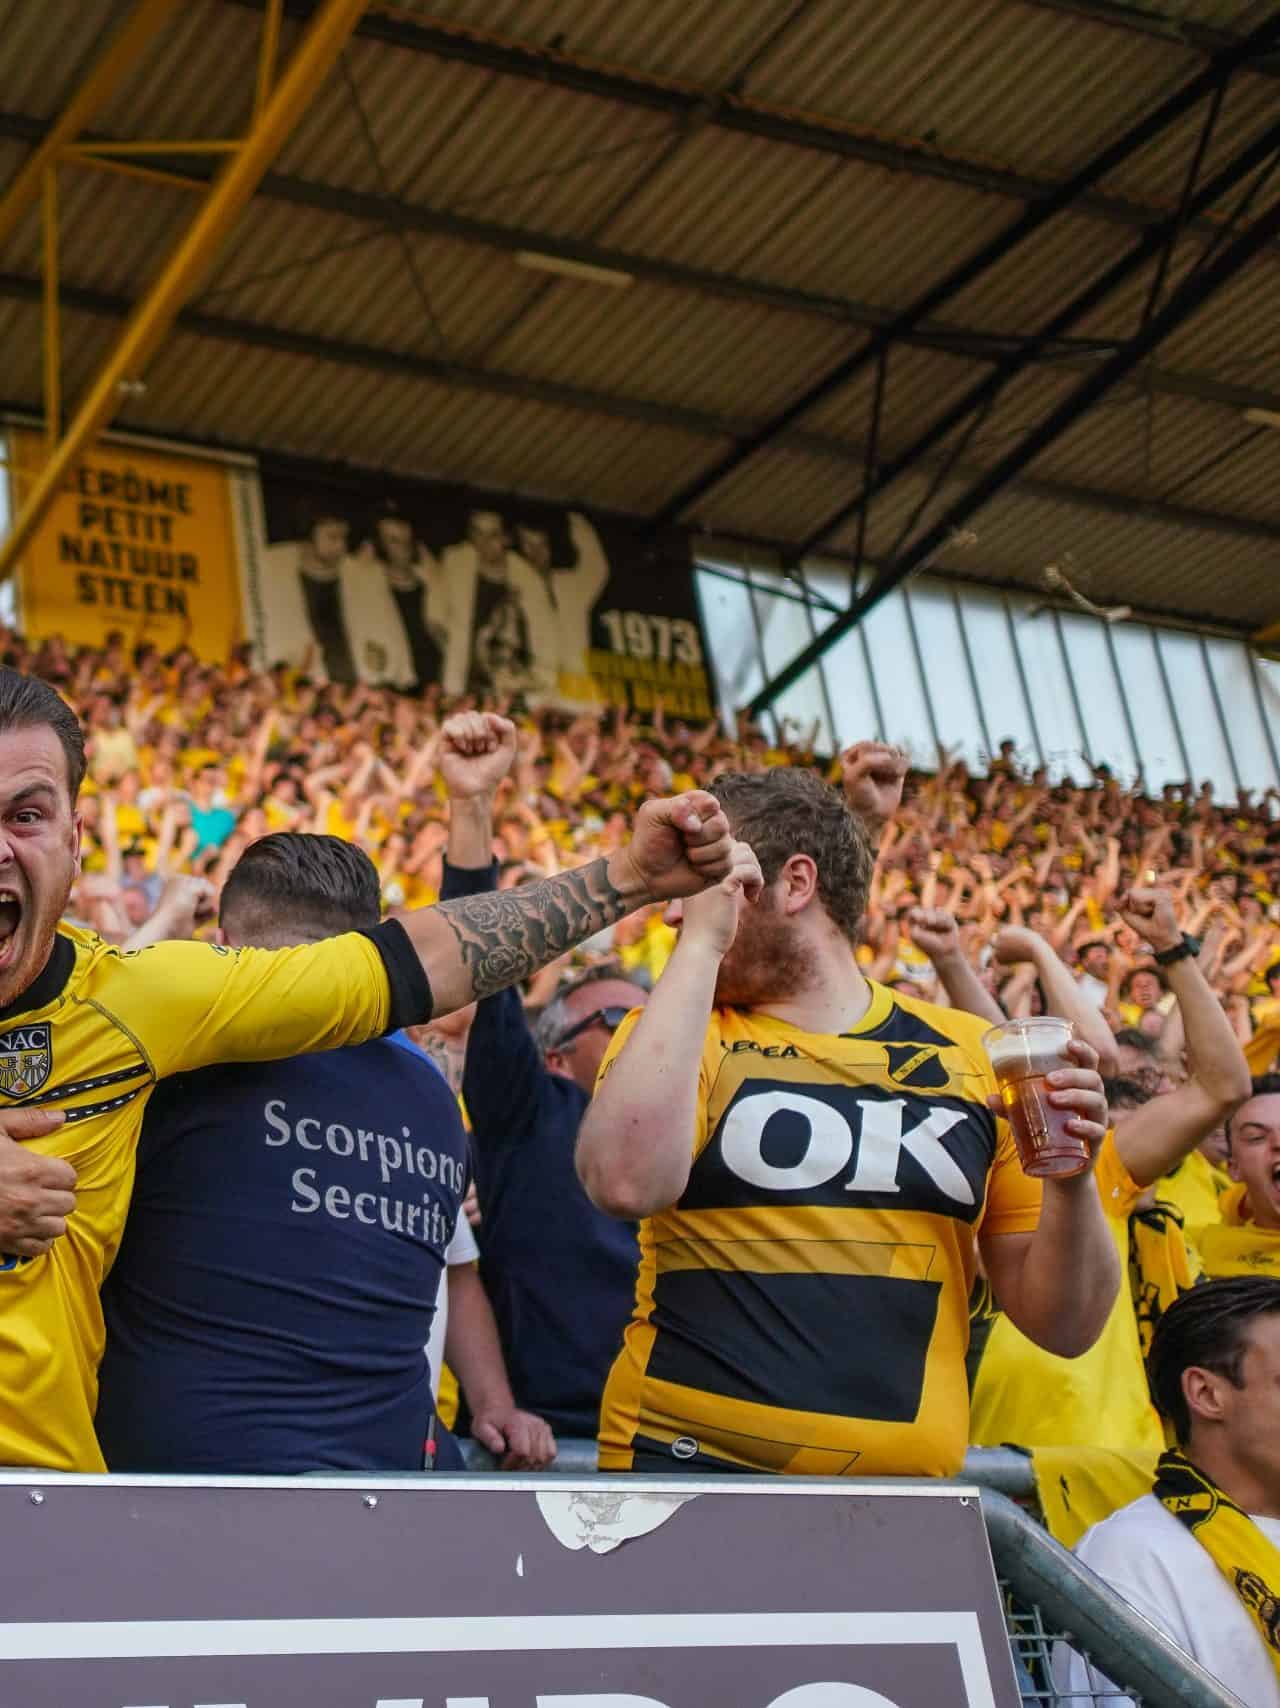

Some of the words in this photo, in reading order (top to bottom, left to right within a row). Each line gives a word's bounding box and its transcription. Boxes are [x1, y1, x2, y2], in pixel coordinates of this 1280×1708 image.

[60, 466, 192, 517] ERÔME
[79, 501, 173, 545] PETIT
[59, 532, 200, 583] NATUUR
[76, 571, 189, 618] STEEN
[600, 609, 701, 664] 1973
[264, 1100, 464, 1195] Scorpions
[721, 1090, 976, 1206] OK
